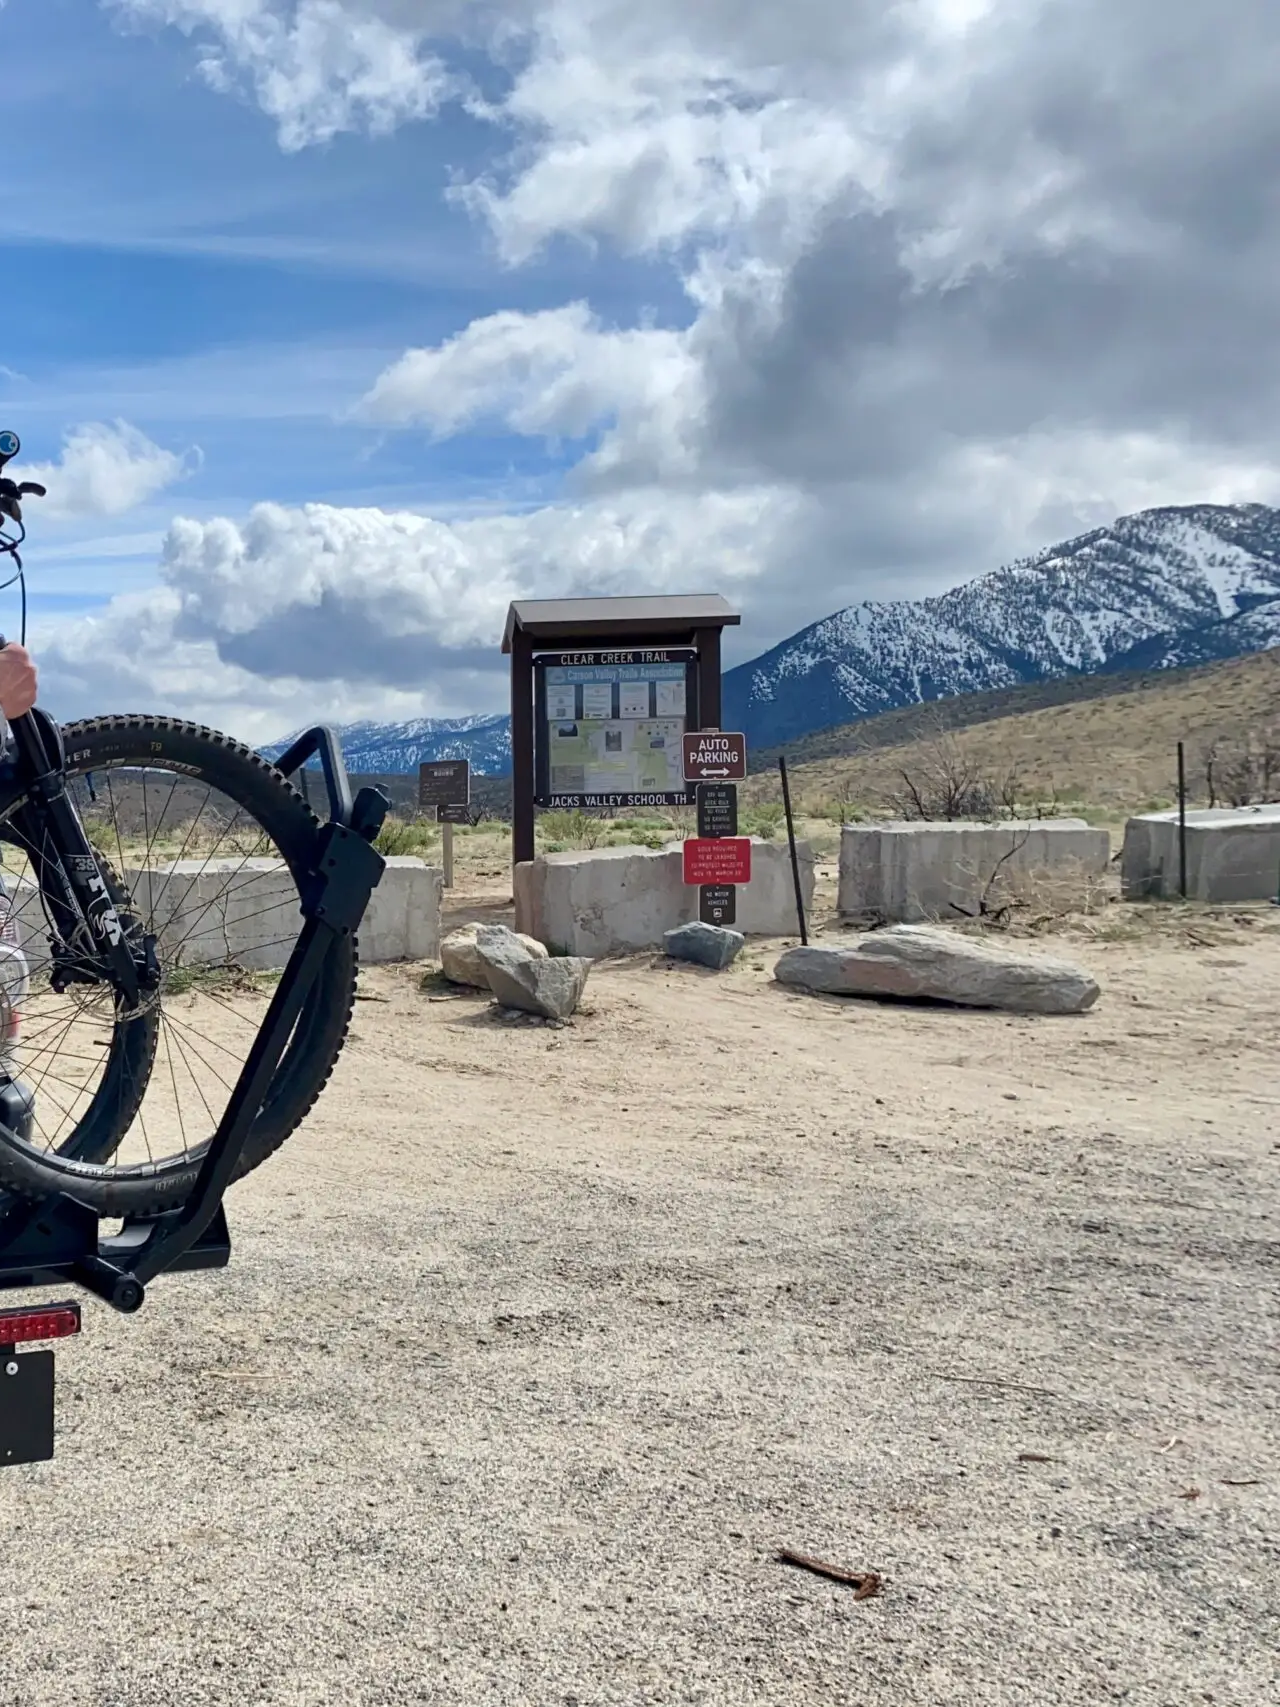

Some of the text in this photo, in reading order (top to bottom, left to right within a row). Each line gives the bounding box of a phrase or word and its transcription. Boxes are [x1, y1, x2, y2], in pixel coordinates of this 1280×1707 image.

[561, 652, 670, 665] CLEAR CREEK TRAIL
[699, 739, 729, 750] AUTO
[690, 751, 739, 764] PARKING
[549, 794, 687, 807] JACKS VALLEY SCHOOL TH
